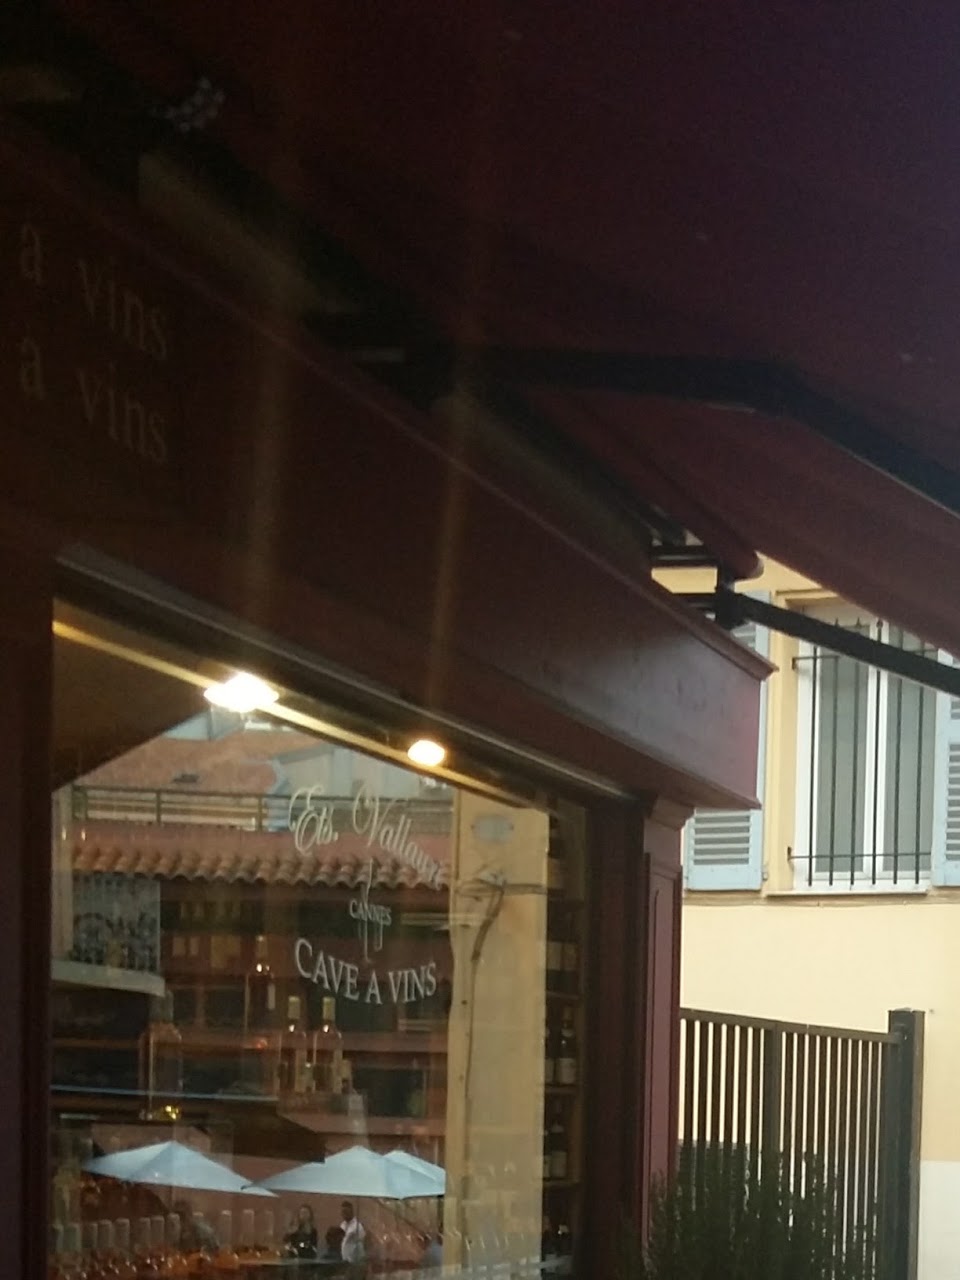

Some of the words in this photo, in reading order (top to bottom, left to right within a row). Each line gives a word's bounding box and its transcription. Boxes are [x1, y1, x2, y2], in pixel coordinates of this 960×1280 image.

[76, 257, 168, 361] vins
[76, 361, 168, 464] vins
[349, 899, 393, 926] CANNES
[294, 937, 360, 1001] CAVE
[387, 961, 437, 1004] VINS
